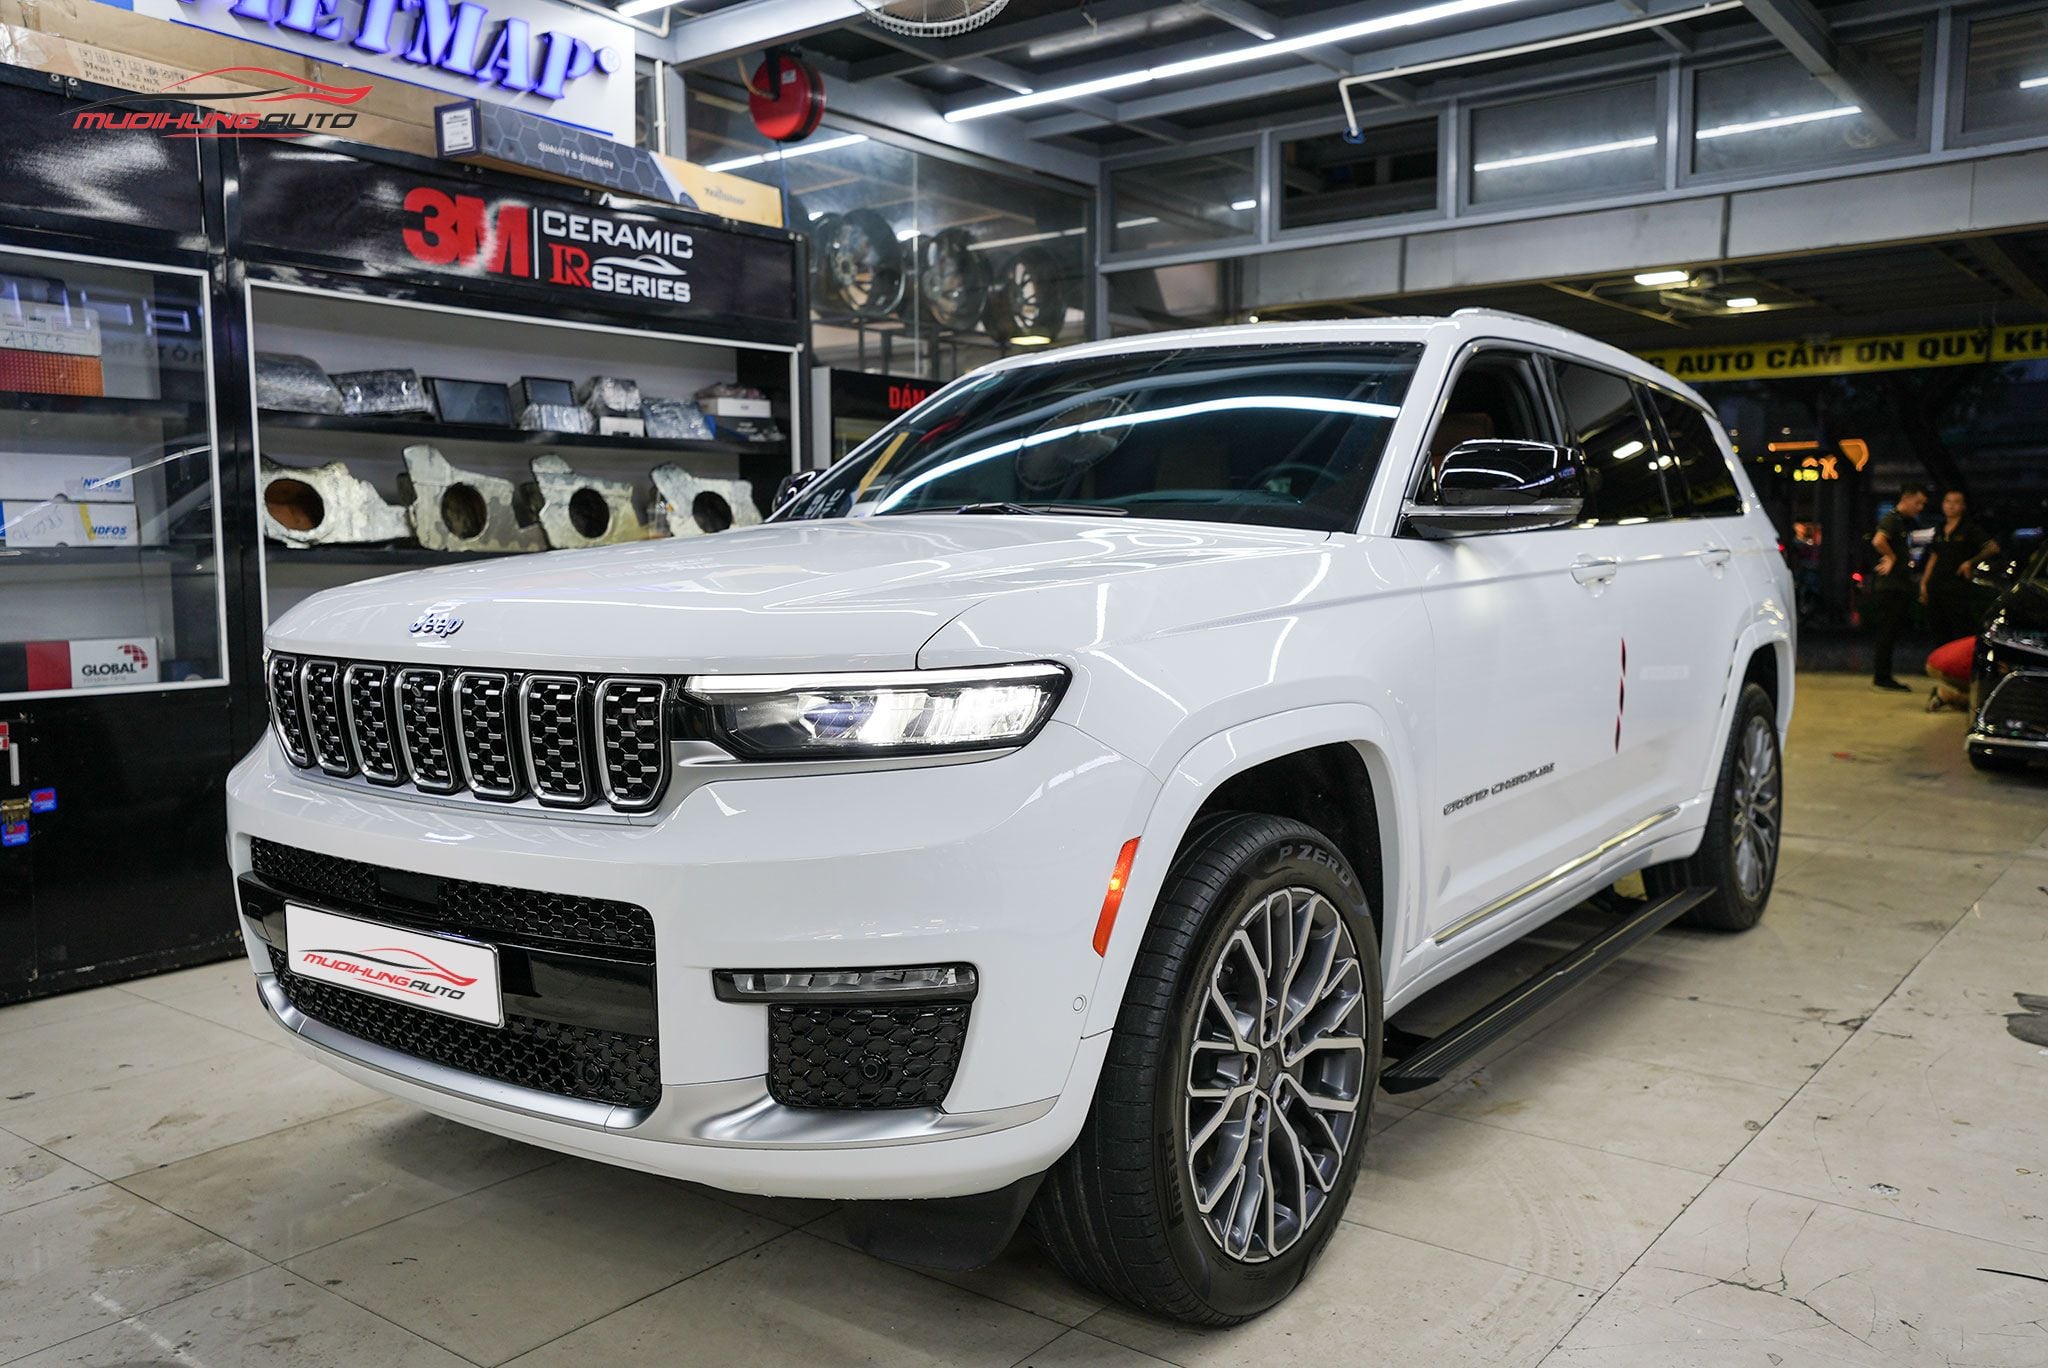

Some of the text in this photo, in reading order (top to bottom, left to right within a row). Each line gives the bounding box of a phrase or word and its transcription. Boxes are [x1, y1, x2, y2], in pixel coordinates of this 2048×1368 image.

[402, 187, 530, 278] 3M
[542, 209, 694, 260] CERAMIC
[592, 264, 692, 304] SERIES
[1676, 352, 1754, 375] AUTO
[82, 663, 137, 677] GLOBAL
[1279, 844, 1352, 888] P ZERO
